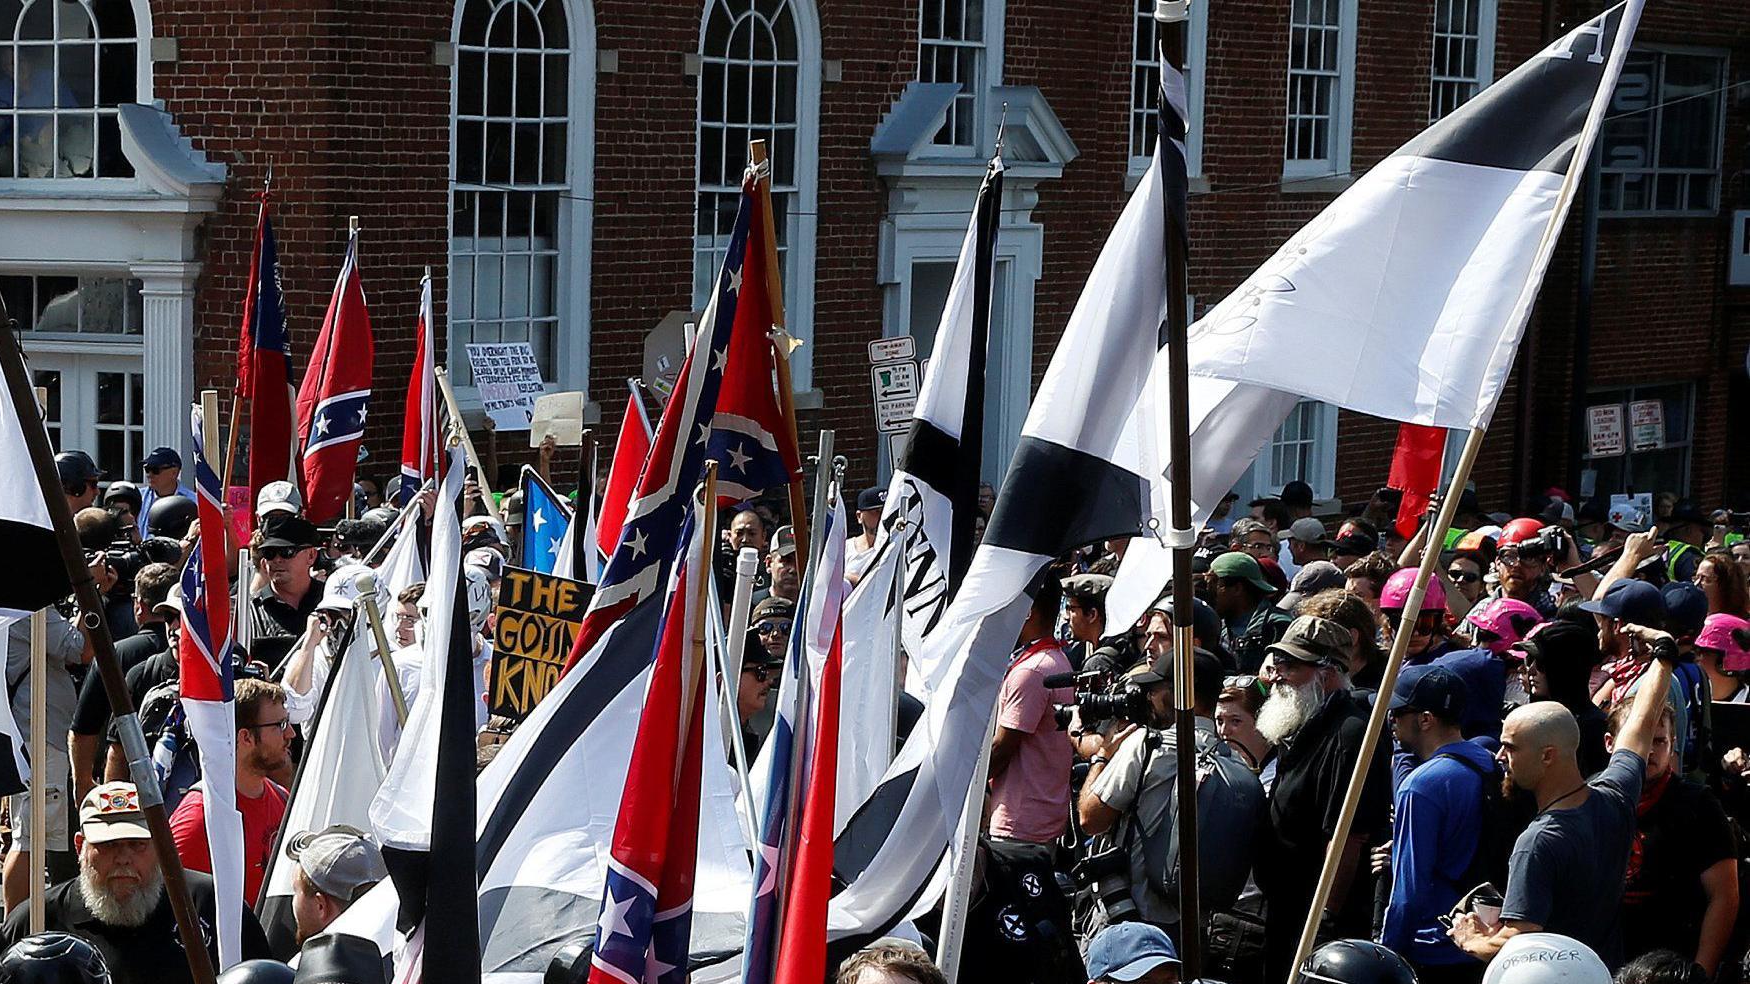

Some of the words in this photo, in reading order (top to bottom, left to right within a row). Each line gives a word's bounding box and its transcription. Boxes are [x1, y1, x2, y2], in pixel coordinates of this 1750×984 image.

[895, 381, 909, 389] ONLY
[891, 401, 914, 410] PARKING
[506, 571, 580, 615] THE
[1502, 950, 1582, 969] OBSERVER
